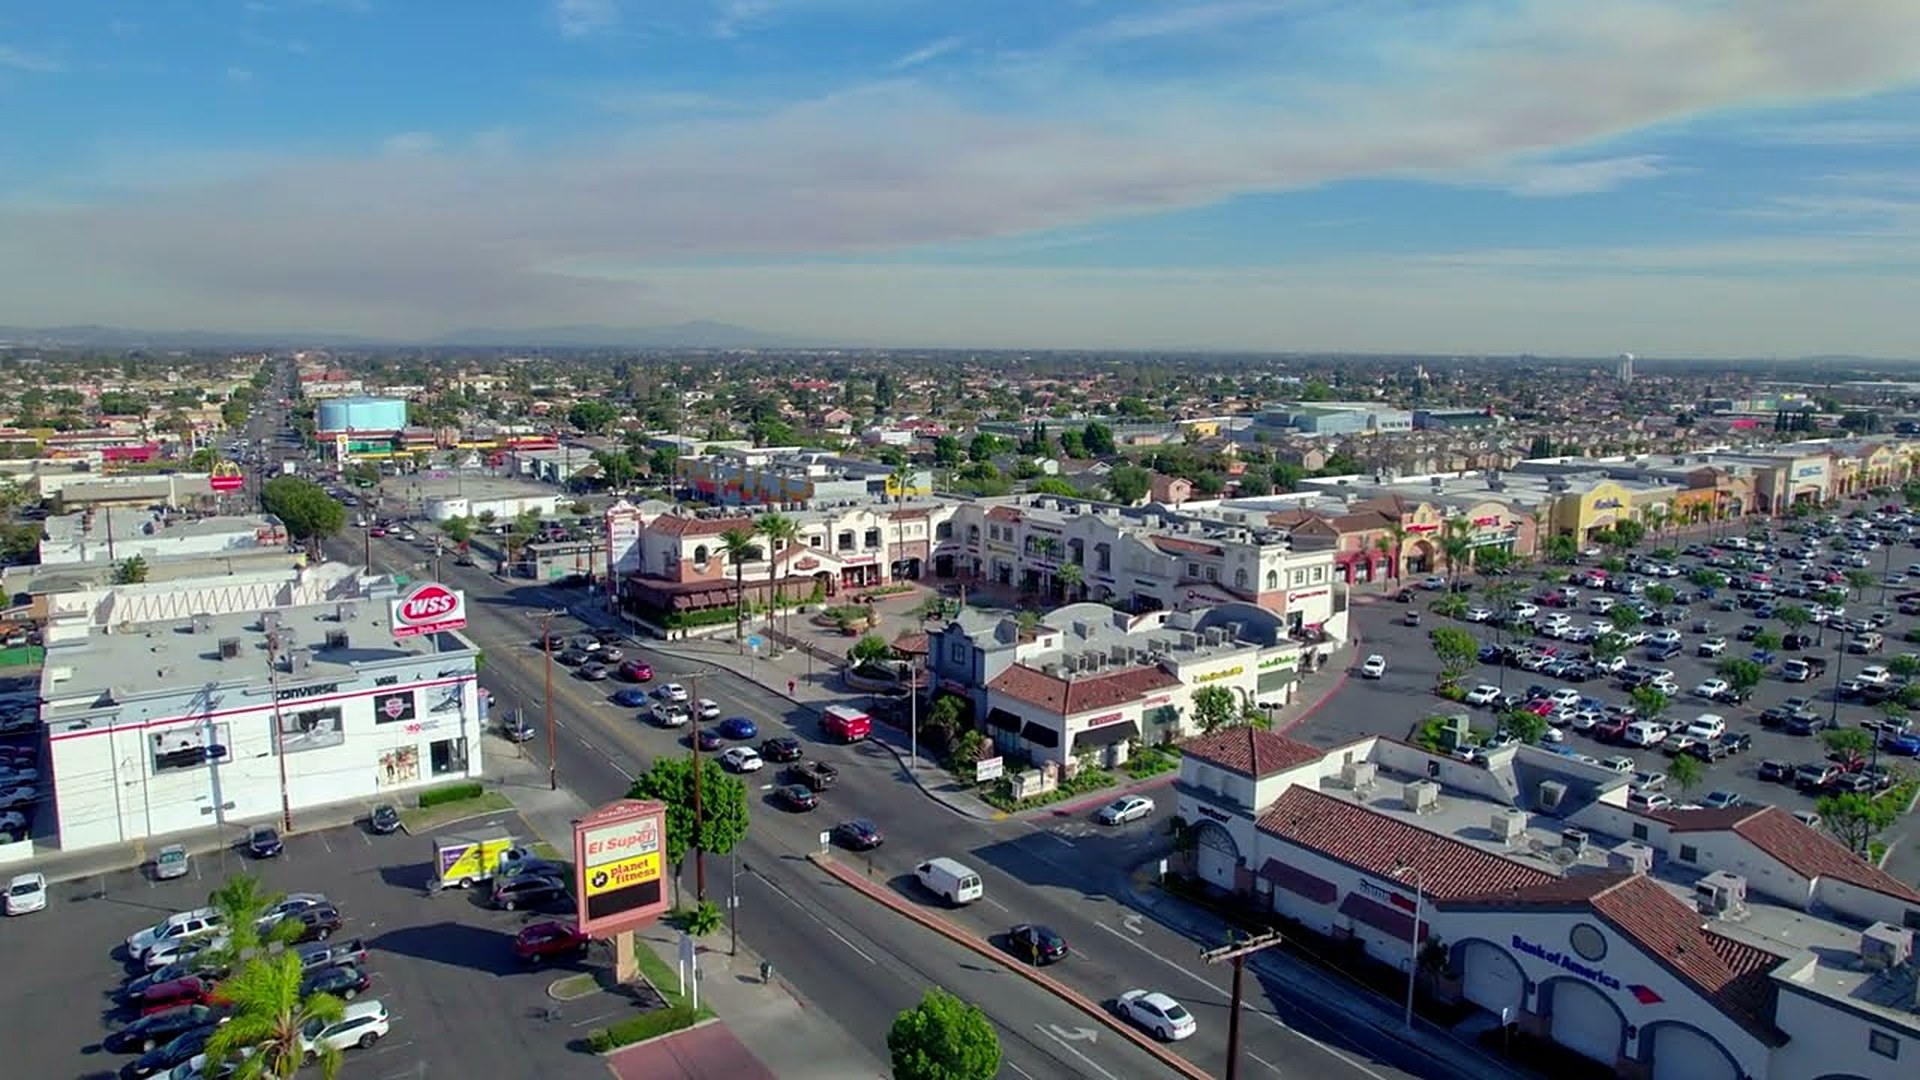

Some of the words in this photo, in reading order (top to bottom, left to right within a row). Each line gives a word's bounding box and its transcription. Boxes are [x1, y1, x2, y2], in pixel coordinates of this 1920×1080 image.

[409, 595, 452, 616] WSS
[588, 841, 604, 855] El
[607, 830, 650, 850] Super
[610, 858, 649, 878] planet
[615, 867, 657, 885] fitness
[1512, 935, 1546, 960] Bank
[1546, 951, 1561, 966] of
[1561, 955, 1620, 991] America
